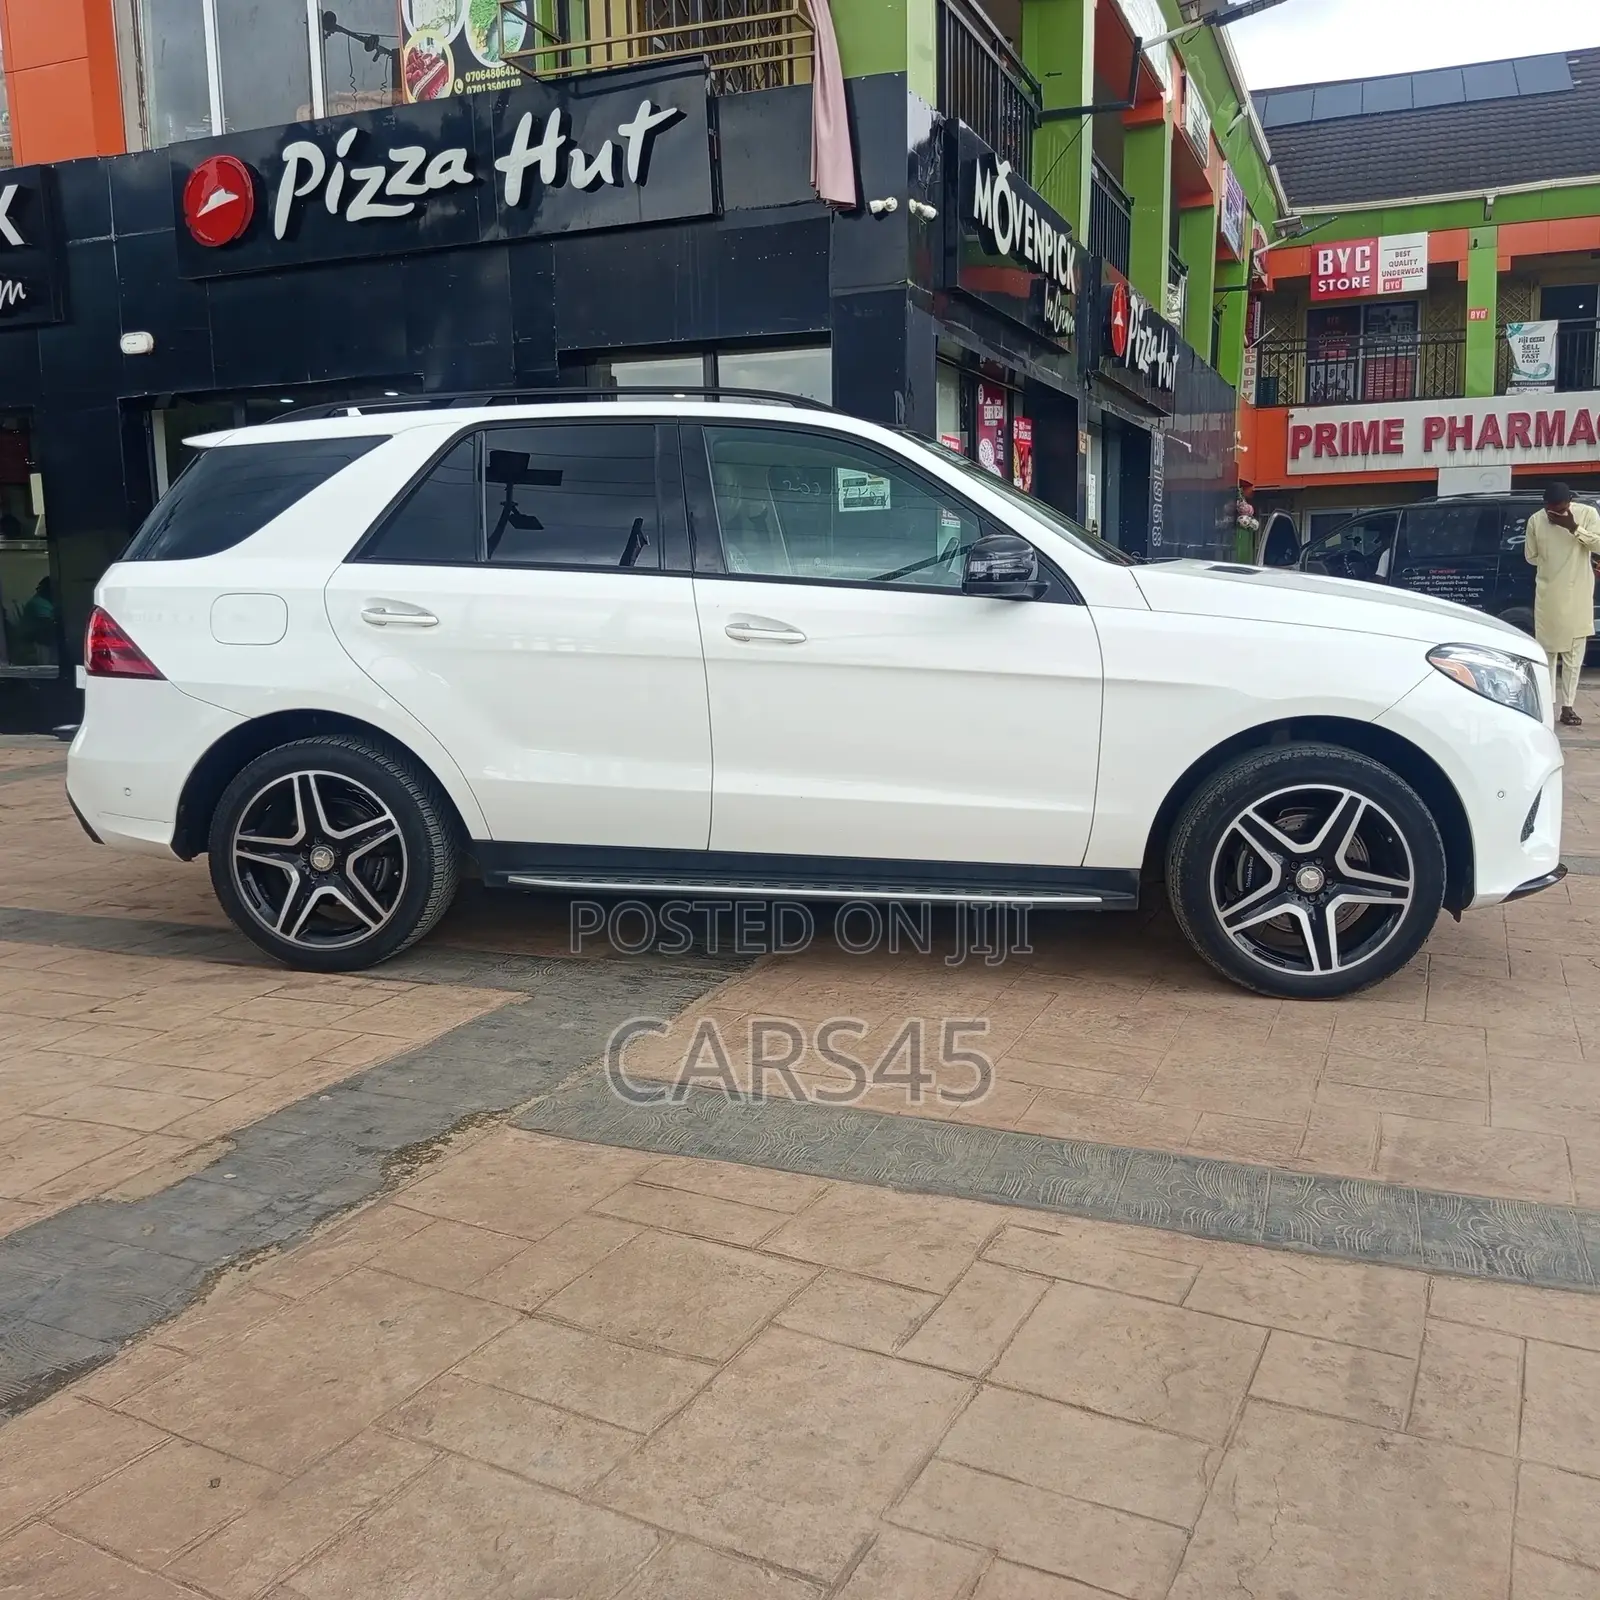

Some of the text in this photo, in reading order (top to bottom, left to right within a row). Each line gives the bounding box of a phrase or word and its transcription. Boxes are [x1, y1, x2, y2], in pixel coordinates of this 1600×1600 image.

[274, 100, 678, 240] Pizza Hut
[1318, 245, 1371, 276] BYC
[1395, 250, 1411, 258] BEST
[1388, 259, 1418, 268] QUALITY
[1381, 267, 1424, 278] UNDERWEAR
[1318, 275, 1370, 292] STORE
[1384, 280, 1401, 290] BYC
[1125, 295, 1180, 393] Pizza Hut
[1290, 409, 1600, 459] PRIME PHARMA
